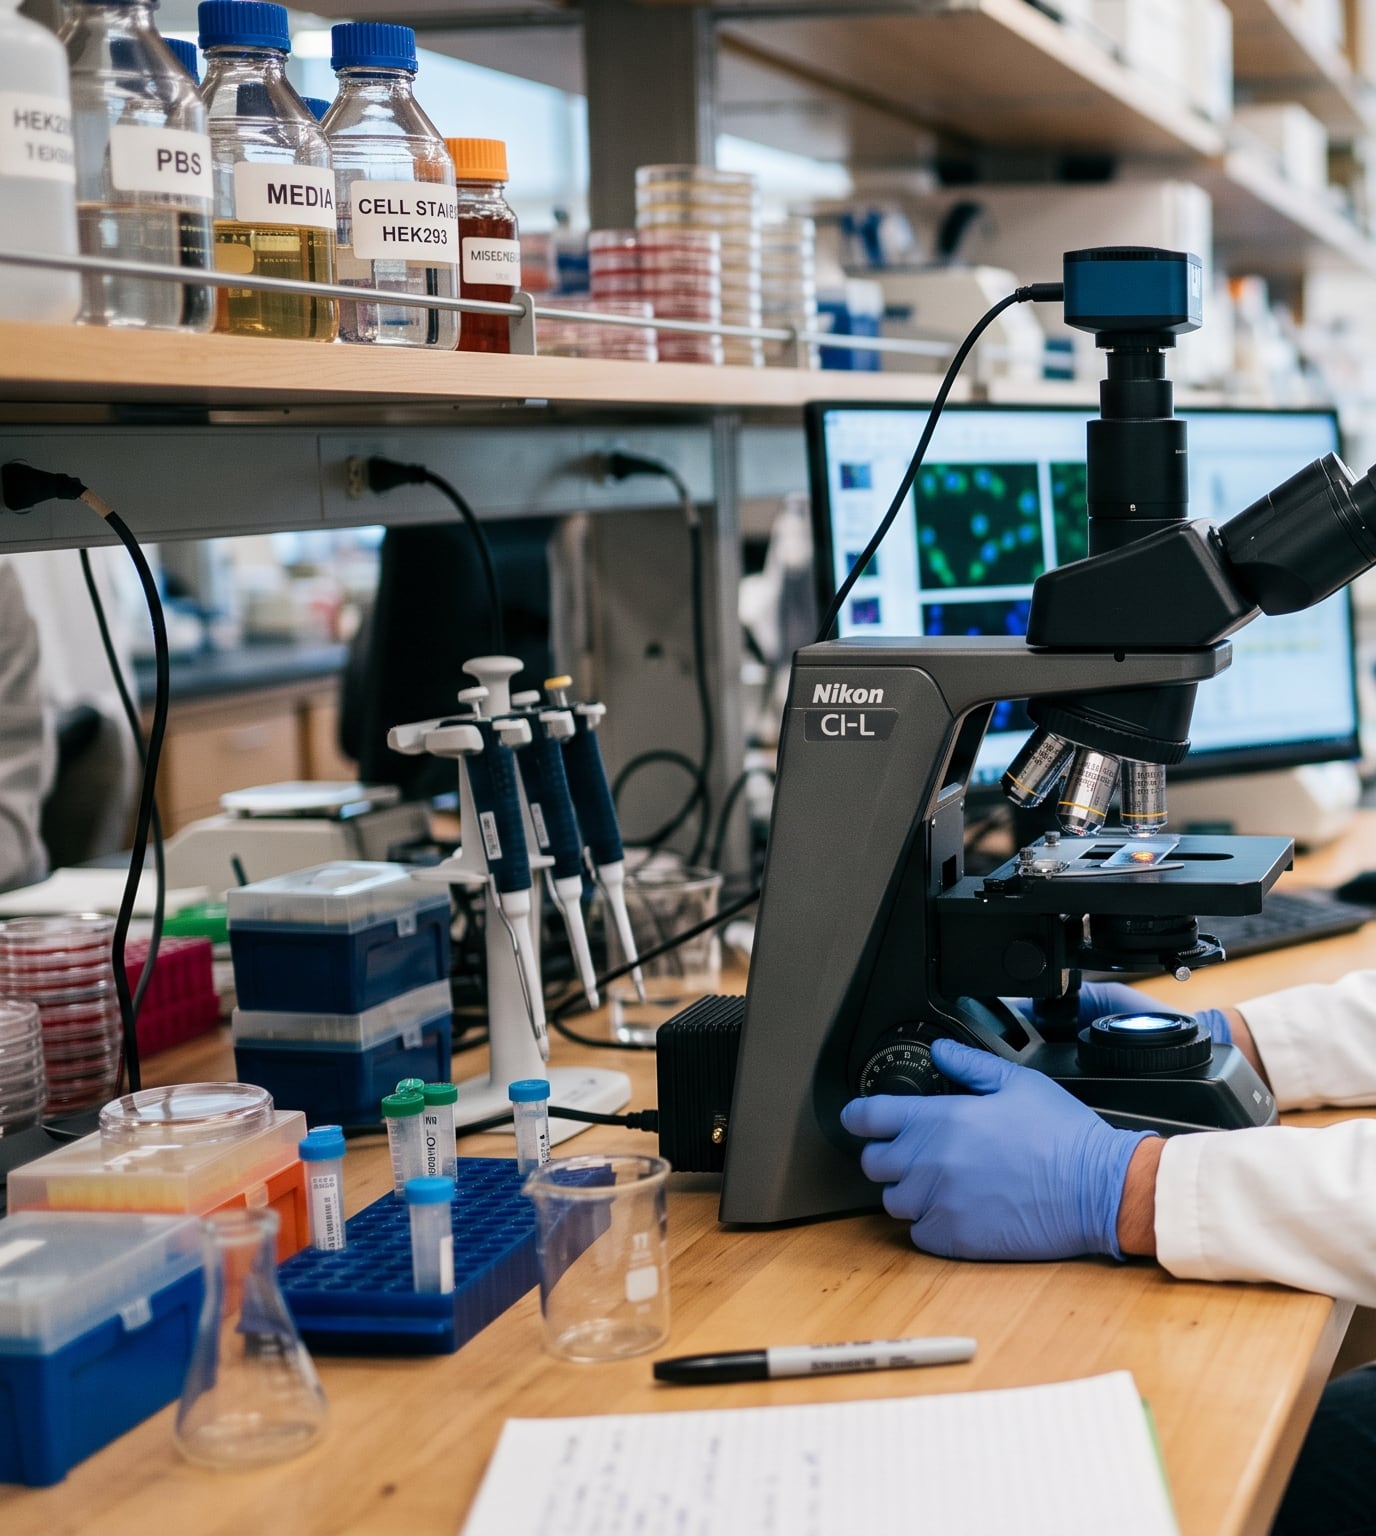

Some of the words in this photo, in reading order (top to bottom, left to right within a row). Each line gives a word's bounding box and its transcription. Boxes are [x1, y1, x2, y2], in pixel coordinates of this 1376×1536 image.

[13, 108, 72, 136] HEK2
[157, 149, 201, 175] PBS
[267, 183, 333, 210] MEDIA
[358, 198, 410, 215] CELL
[383, 226, 448, 245] HEK293
[812, 683, 884, 704] Nikon
